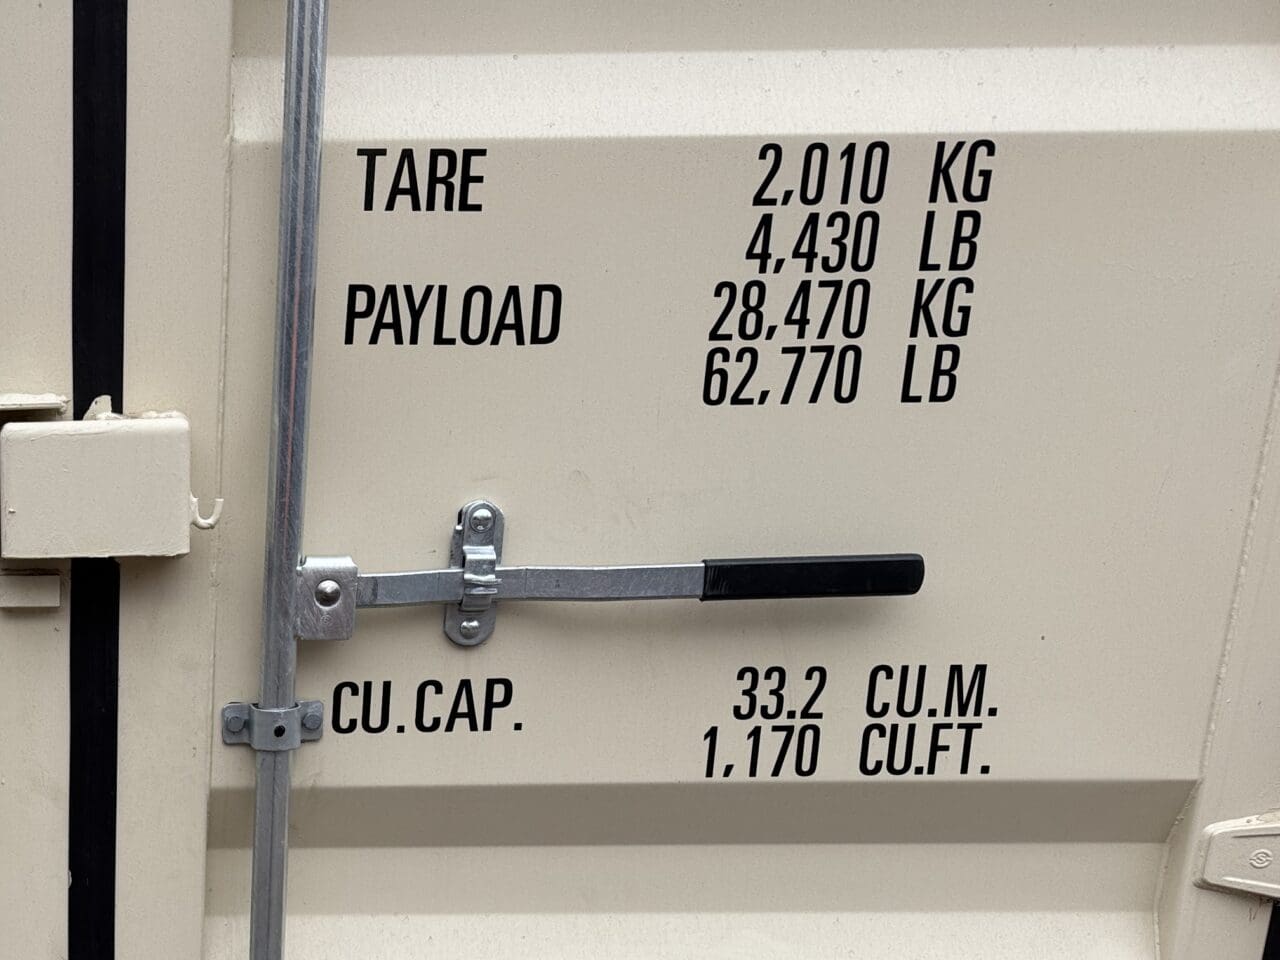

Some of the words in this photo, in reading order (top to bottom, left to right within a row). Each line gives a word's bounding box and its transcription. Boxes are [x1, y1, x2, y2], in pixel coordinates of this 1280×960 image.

[356, 148, 487, 211] TARE
[752, 141, 890, 207] 2,010
[928, 139, 995, 204] KG
[745, 212, 881, 274] 4,430
[918, 210, 982, 272] LB
[343, 284, 563, 346] PAYLOAD
[708, 279, 871, 342] 28,470
[908, 277, 974, 340] KG
[702, 345, 863, 406] 62,770
[900, 344, 961, 404] LB
[331, 678, 523, 734] CU.CAP.
[732, 666, 828, 720] 33.2
[865, 664, 999, 718] CU.M.
[703, 725, 821, 778] 1,170
[858, 723, 991, 776] CU.FT.
